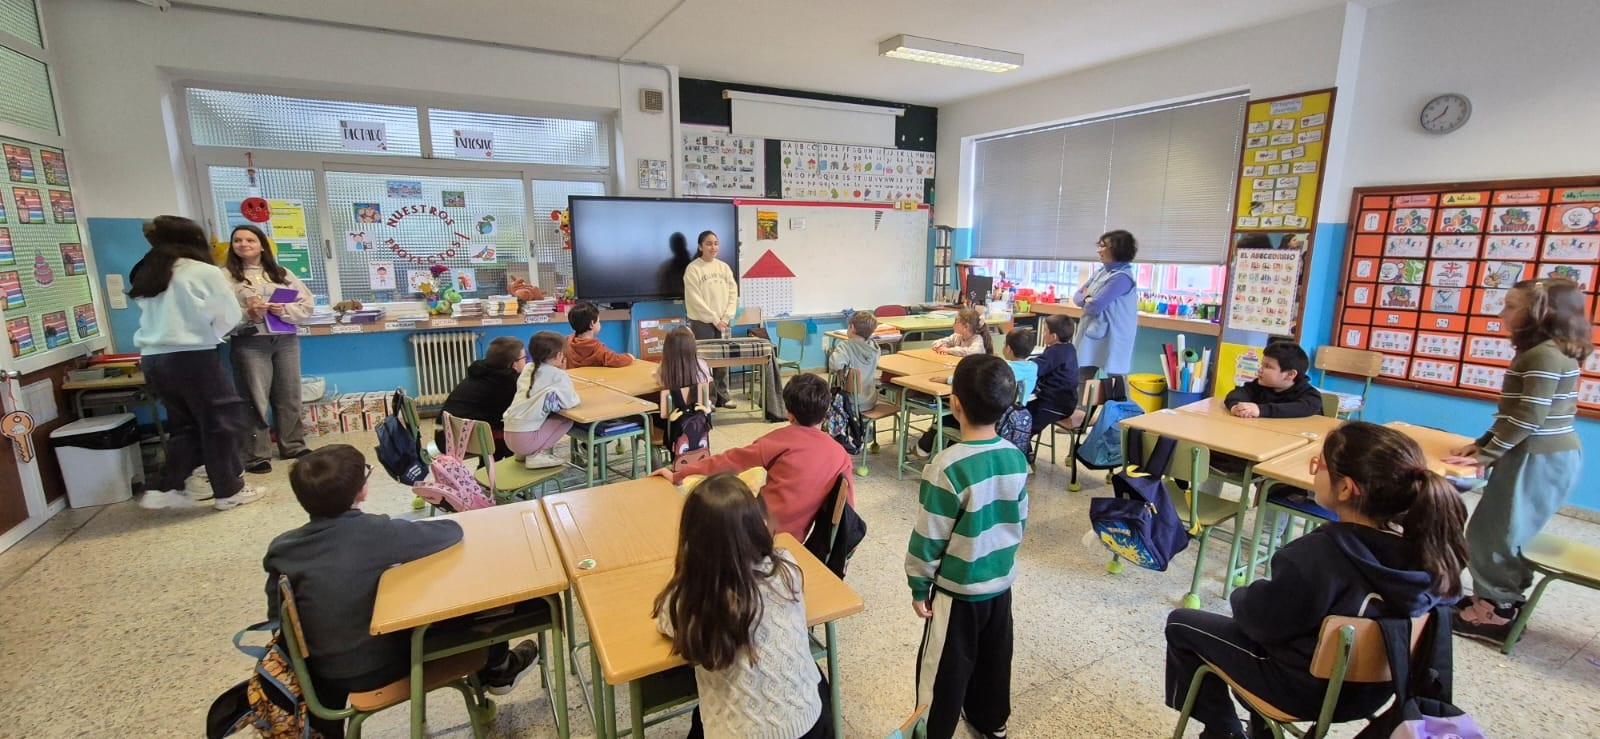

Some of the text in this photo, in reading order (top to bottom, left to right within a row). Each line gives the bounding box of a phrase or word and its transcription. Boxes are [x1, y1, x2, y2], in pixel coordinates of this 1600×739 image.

[343, 128, 383, 142] DICTADO
[455, 136, 493, 151] EXPLOSIVO
[387, 204, 455, 228] NUESTROS
